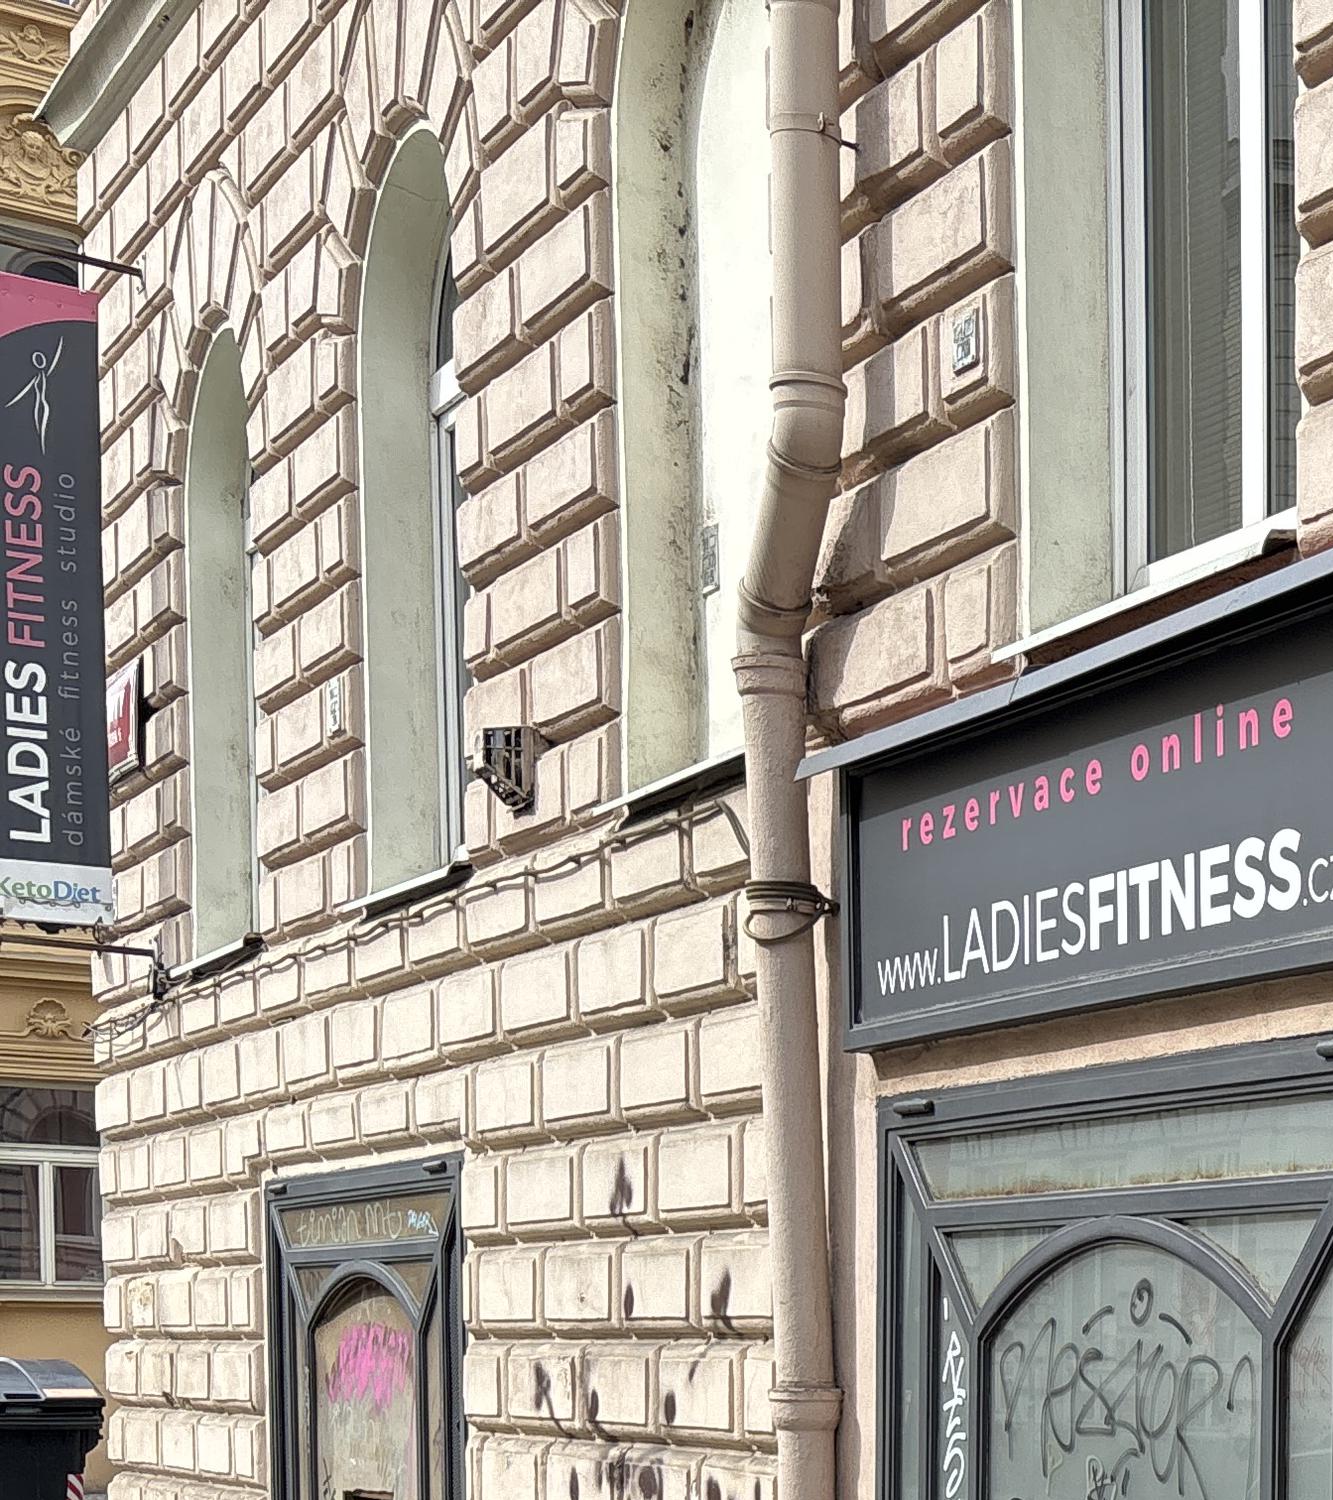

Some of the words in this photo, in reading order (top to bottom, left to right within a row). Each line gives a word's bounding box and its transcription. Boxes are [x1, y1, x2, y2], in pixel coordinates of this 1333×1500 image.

[4, 464, 46, 649] FITNESS
[53, 473, 77, 572] studio
[58, 598, 80, 701] fitness
[5, 659, 52, 844] LADIES
[60, 727, 84, 847] dámské
[901, 761, 1104, 852] rezervace
[1129, 696, 1296, 785] online
